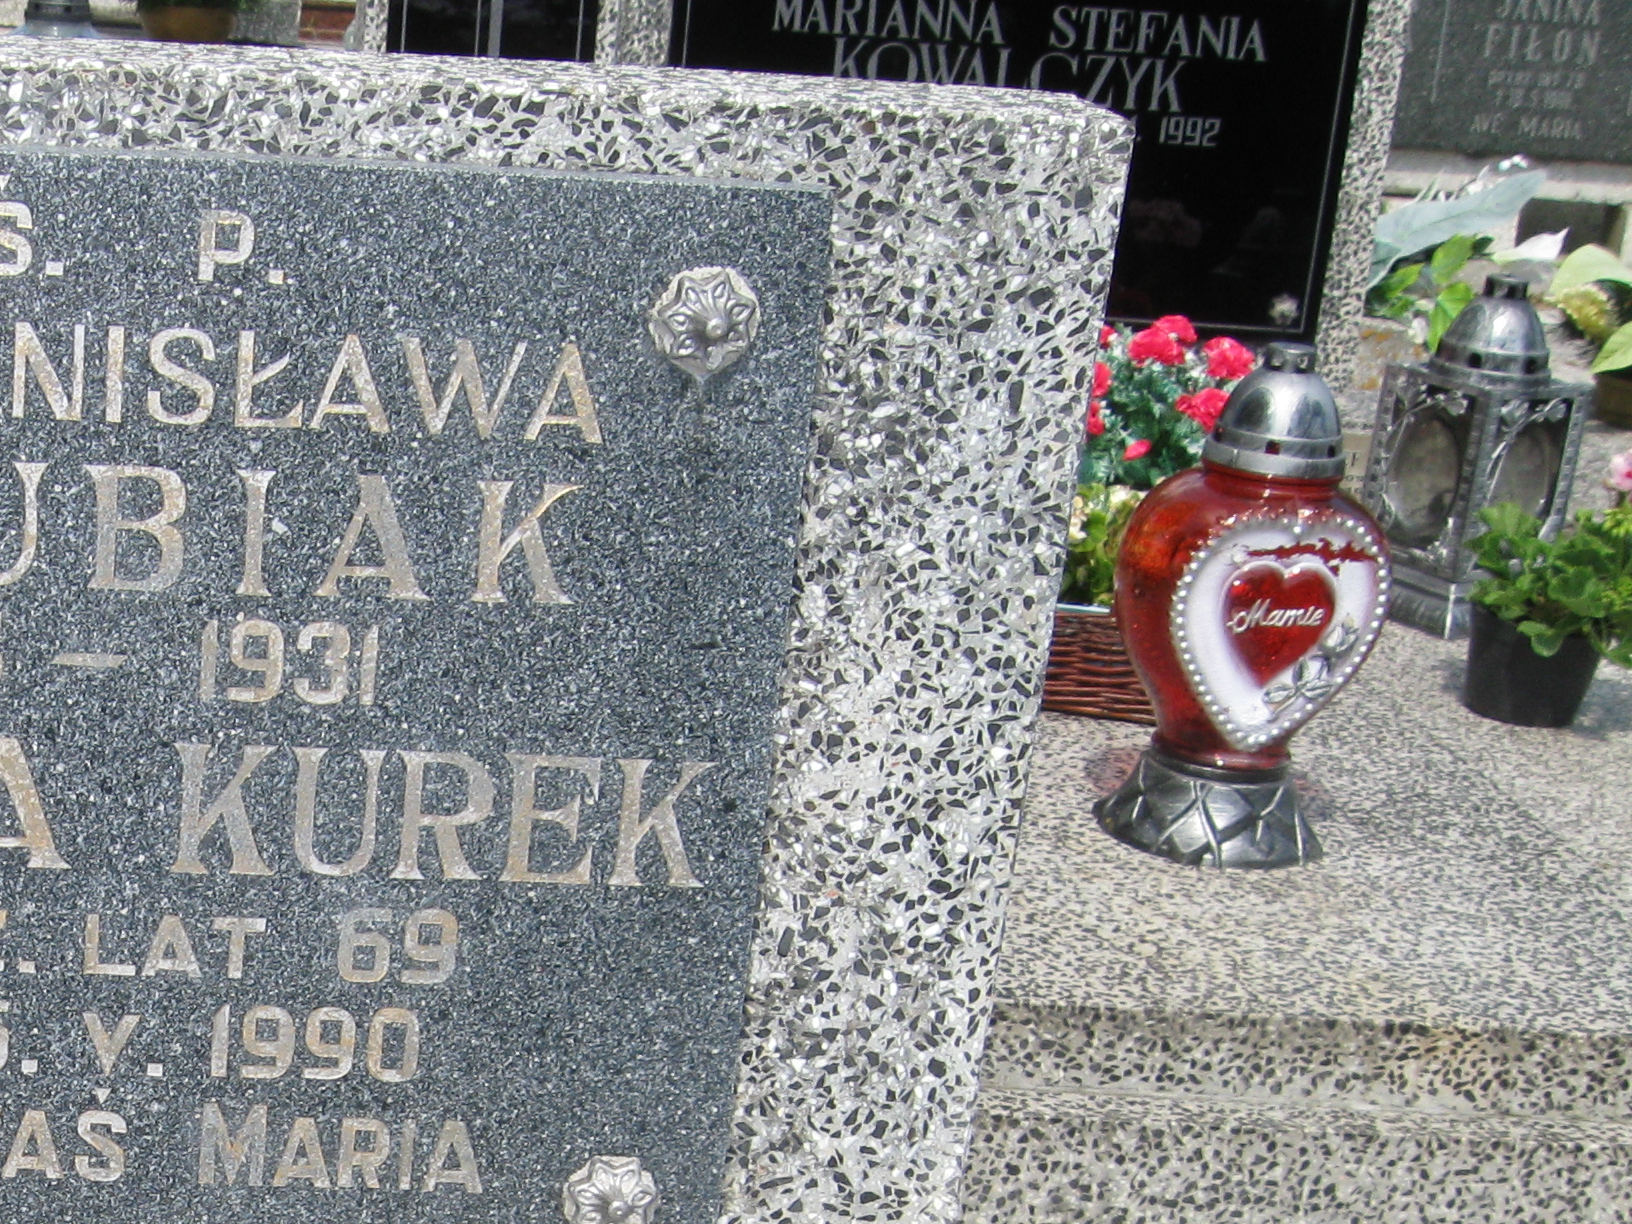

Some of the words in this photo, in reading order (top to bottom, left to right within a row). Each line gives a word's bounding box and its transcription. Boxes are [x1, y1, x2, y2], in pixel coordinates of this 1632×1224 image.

[1049, 5, 1267, 62] STEFANIA
[1158, 115, 1222, 147] 1992
[197, 209, 287, 285] P.
[1226, 599, 1326, 635] Mamie
[198, 616, 379, 707] 1931
[169, 738, 719, 889] KUREK
[83, 914, 267, 979] LAT
[336, 907, 459, 985] 69
[208, 1004, 421, 1083] 1990
[197, 1100, 483, 1194] MARIA
